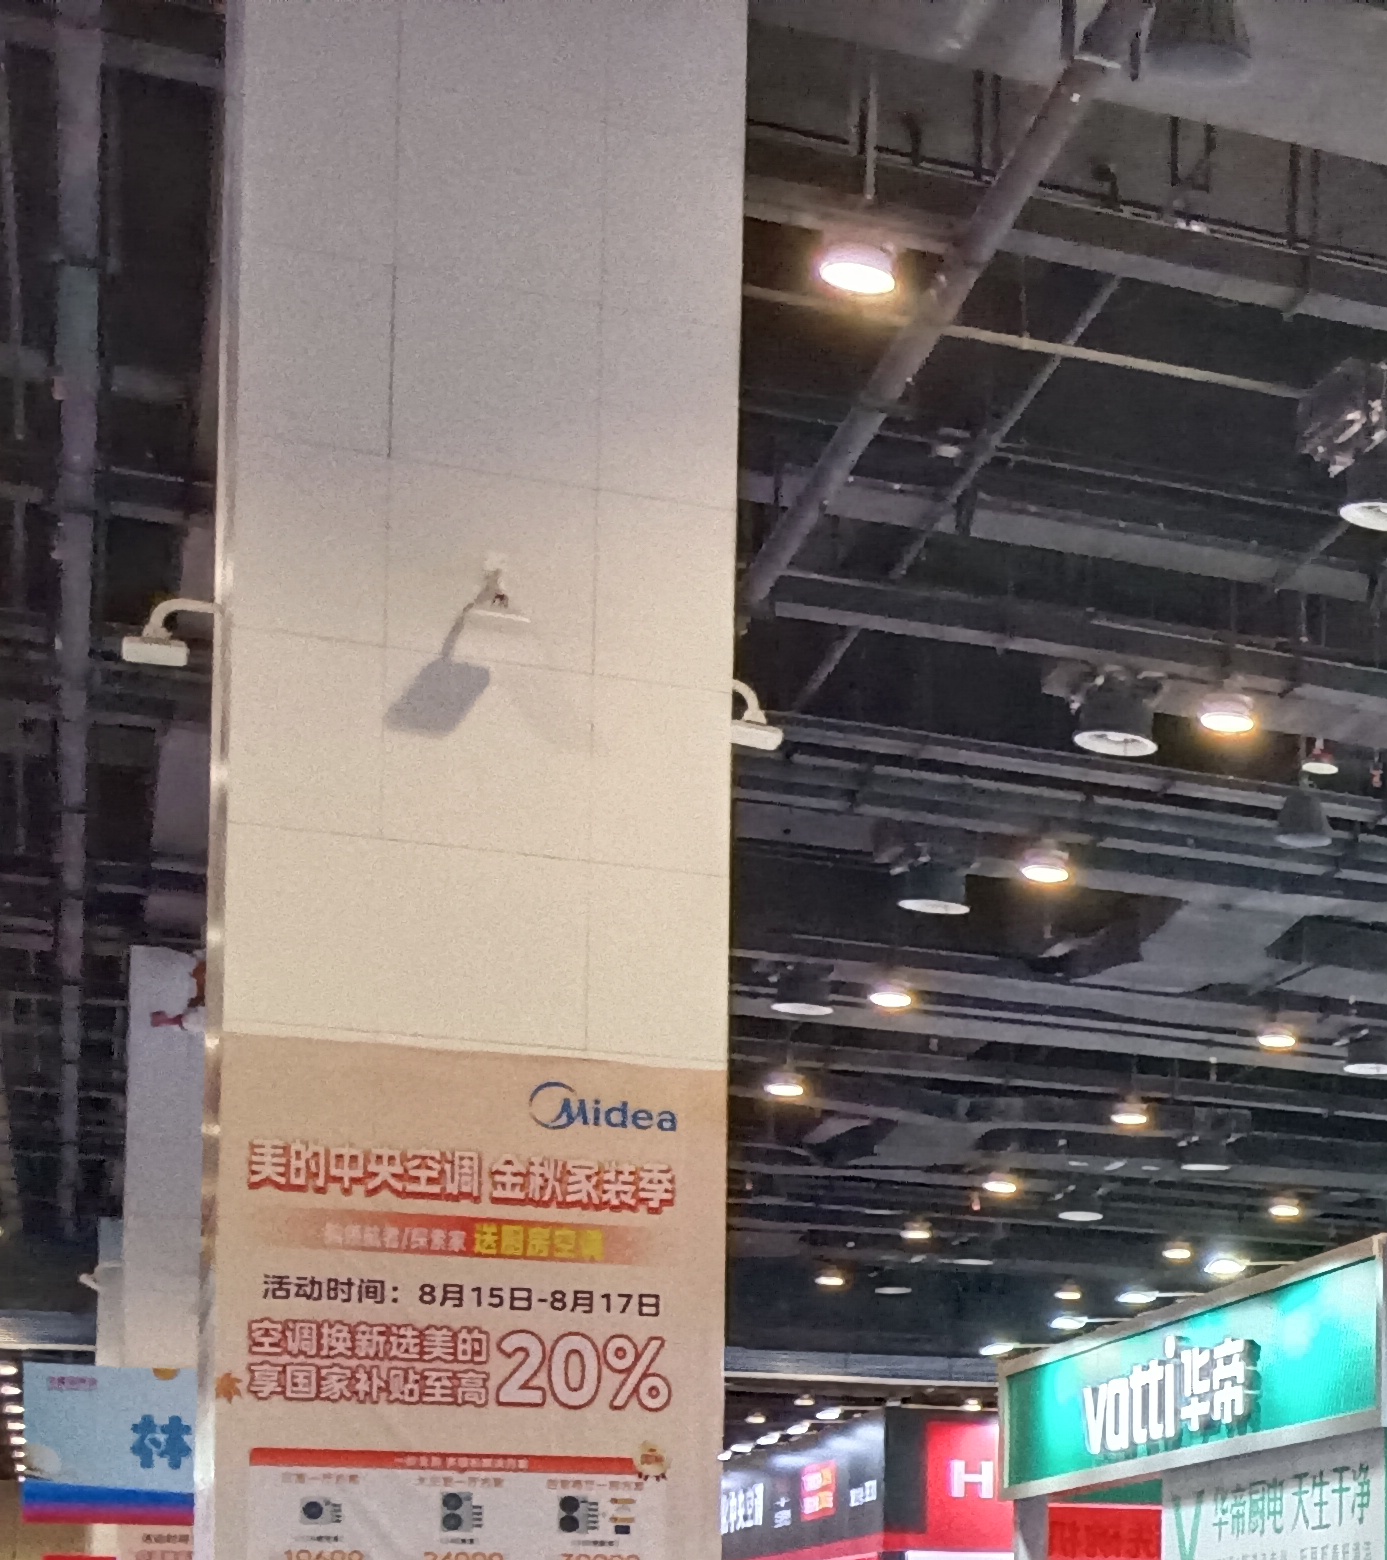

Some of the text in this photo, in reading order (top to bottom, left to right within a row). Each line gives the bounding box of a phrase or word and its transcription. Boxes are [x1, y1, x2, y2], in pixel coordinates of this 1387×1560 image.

[529, 1081, 678, 1132] Midea
[247, 1138, 677, 1215] 美的中央空调 金秋家装季
[248, 1318, 490, 1364] 空调换新选美的
[496, 1329, 673, 1413] 20%
[248, 1363, 490, 1408] 享国家补贴至高
[1083, 1335, 1246, 1456] vatti 华帝
[1212, 1475, 1286, 1543] 华帝厨电
[1291, 1461, 1372, 1533] 天生干净
